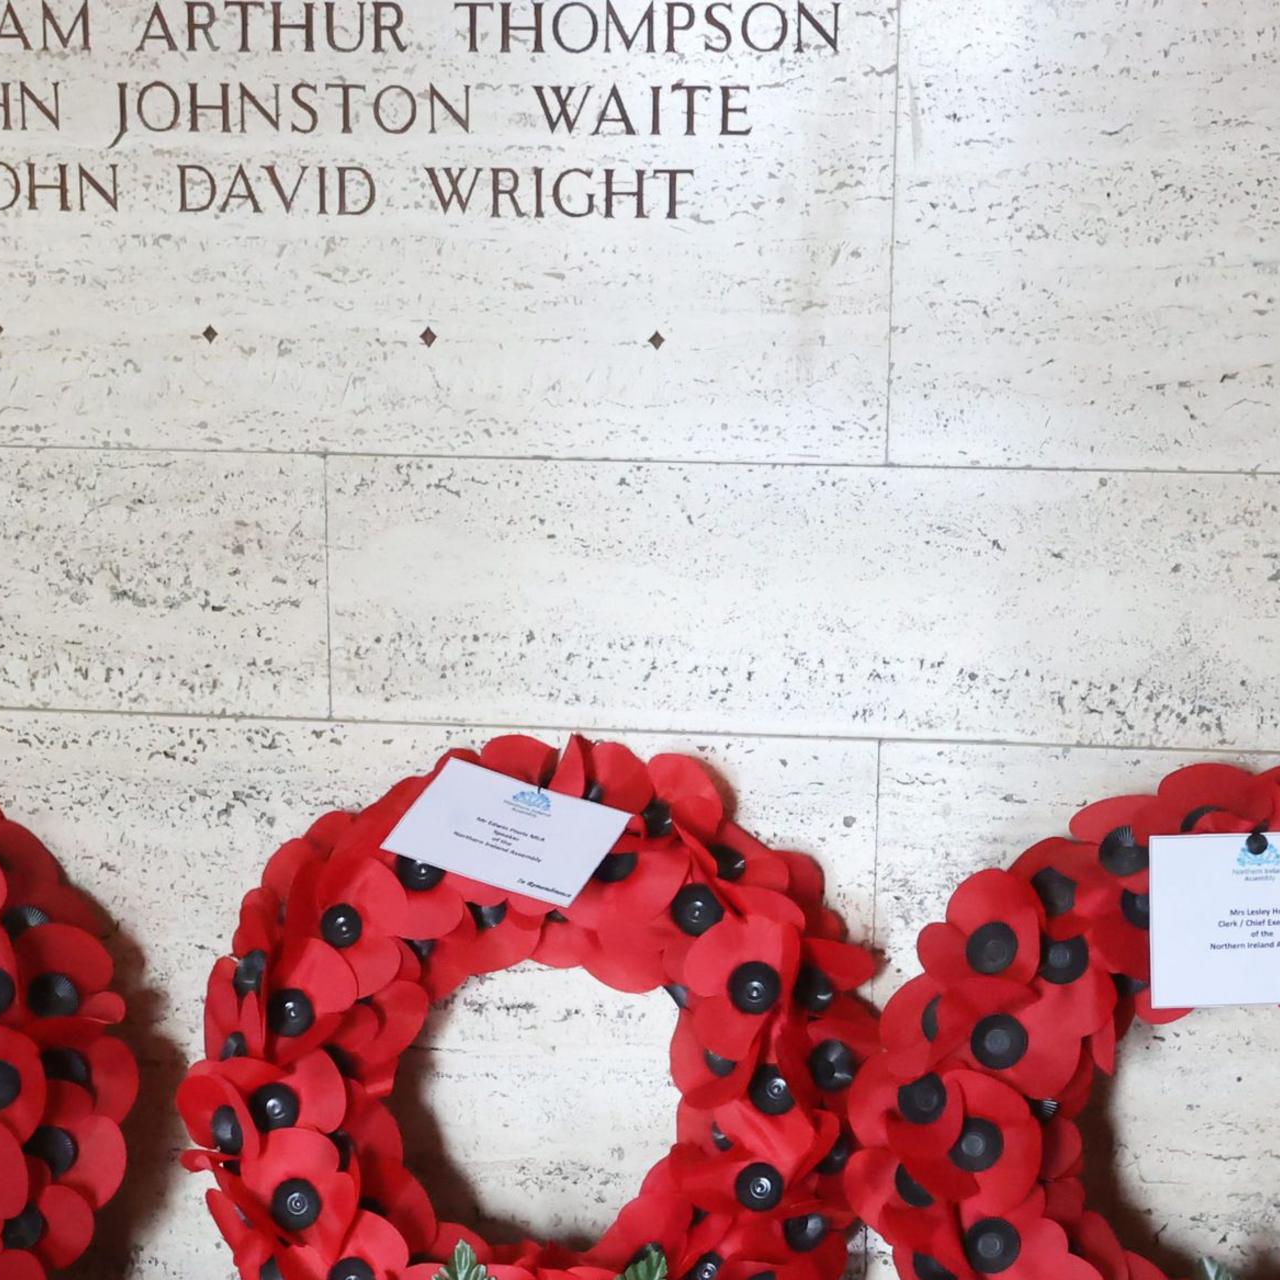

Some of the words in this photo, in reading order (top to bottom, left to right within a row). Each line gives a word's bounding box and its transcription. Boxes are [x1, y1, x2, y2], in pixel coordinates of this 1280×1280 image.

[135, 0, 409, 53] ARTHUR
[454, 0, 841, 53] THOMPSON
[108, 80, 472, 149] JOHNSTON
[532, 82, 753, 137] WAITE
[177, 162, 376, 216] DAVID
[424, 167, 695, 220] WRIGHT
[453, 830, 484, 844] Northern
[485, 841, 509, 853] Ireland
[510, 849, 542, 864] Assembly
[1230, 908, 1245, 916] Mrs
[1247, 908, 1271, 917] Lesley
[1217, 920, 1237, 928] Clerk
[1260, 930, 1274, 938] the
[1210, 942, 1246, 950] Northern
[1247, 941, 1275, 949] Ireland
